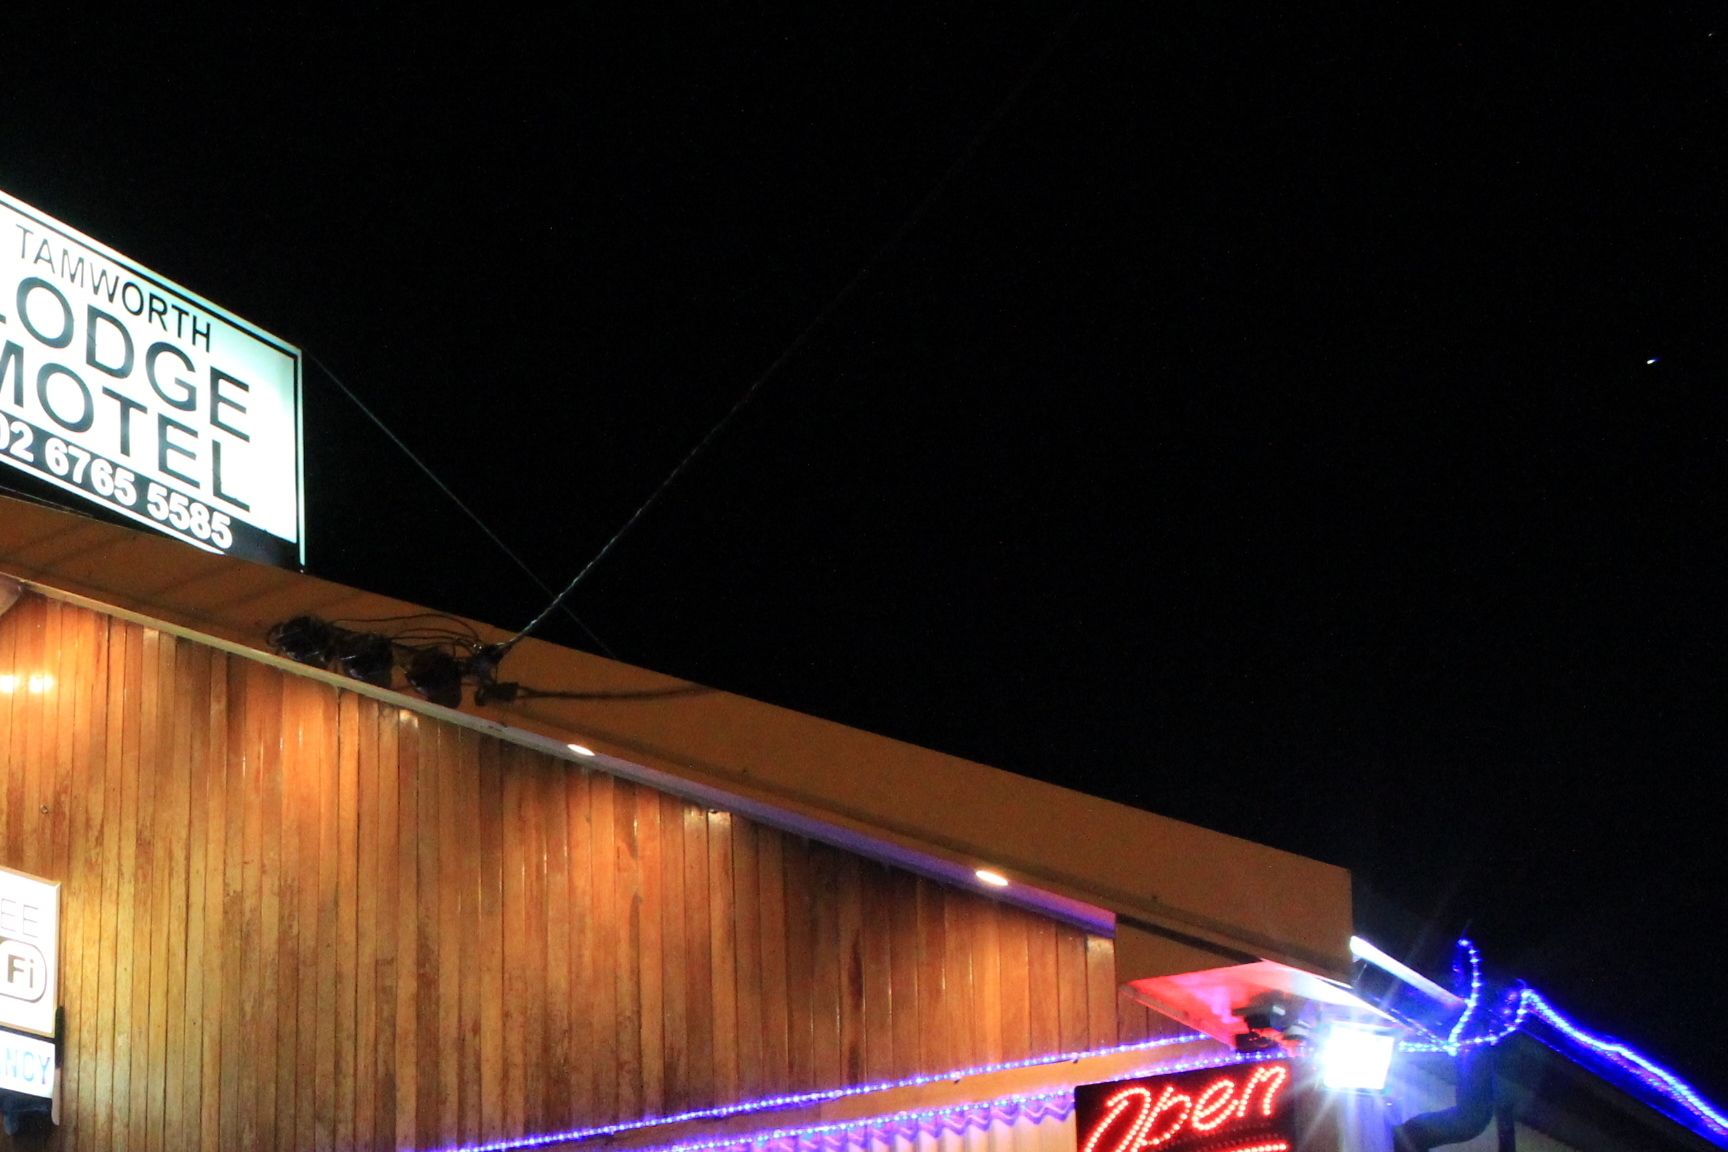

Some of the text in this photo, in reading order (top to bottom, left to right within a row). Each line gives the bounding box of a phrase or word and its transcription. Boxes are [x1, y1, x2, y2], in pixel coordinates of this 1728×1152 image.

[16, 224, 212, 353] TAMWORTH
[44, 442, 138, 507] 6765
[146, 484, 234, 550] 5585
